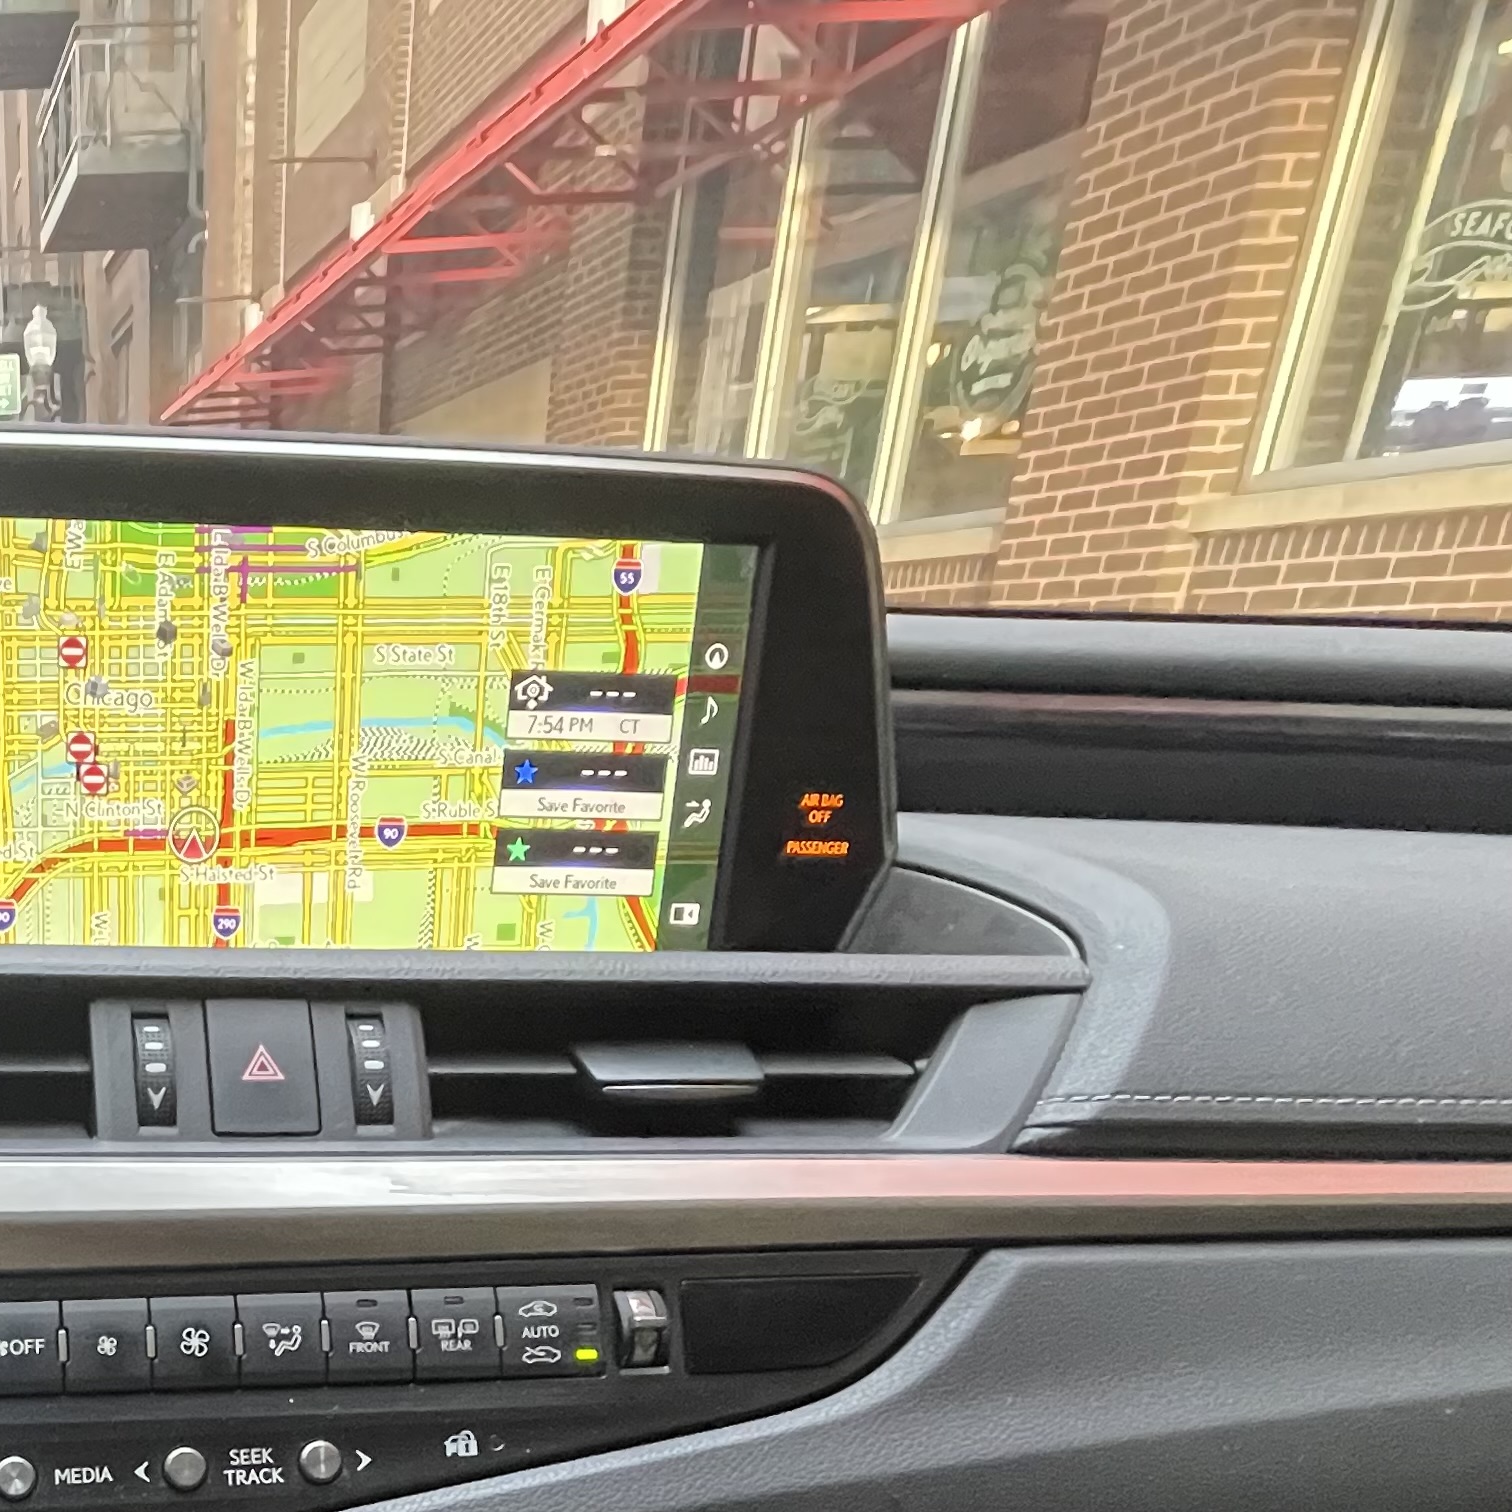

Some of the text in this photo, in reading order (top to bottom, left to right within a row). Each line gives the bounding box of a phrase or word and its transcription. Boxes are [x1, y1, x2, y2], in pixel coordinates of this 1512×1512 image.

[536, 567, 552, 579] E
[619, 571, 636, 585] 55
[490, 565, 510, 649] E 18th St
[532, 587, 552, 653] Cermak
[376, 645, 454, 663] S State St
[239, 660, 254, 678] W
[527, 716, 640, 734] 7:54 PM CT
[236, 738, 251, 779] Wells
[439, 750, 496, 764] S Canal
[234, 789, 250, 809] Dr
[537, 797, 625, 814] Save Favorite
[66, 801, 162, 816] N Clinton St
[422, 804, 431, 818] S
[438, 803, 480, 817] Ruble
[808, 810, 832, 823] OFF
[347, 756, 366, 889] W Roosevelt Rd
[383, 827, 399, 840] 90
[17, 845, 34, 860] St
[786, 840, 849, 855] PASSENGER
[180, 864, 275, 881] S Halsted St
[529, 874, 617, 891] Save Favorite
[217, 918, 236, 930] 290
[522, 1325, 559, 1339] AUTO
[9, 1337, 45, 1356] OFF
[349, 1340, 389, 1354] FRONT
[441, 1339, 472, 1353] REAR
[229, 1448, 273, 1466] SEEK
[54, 1466, 113, 1485] MEDIA
[224, 1466, 284, 1486] TRACK
